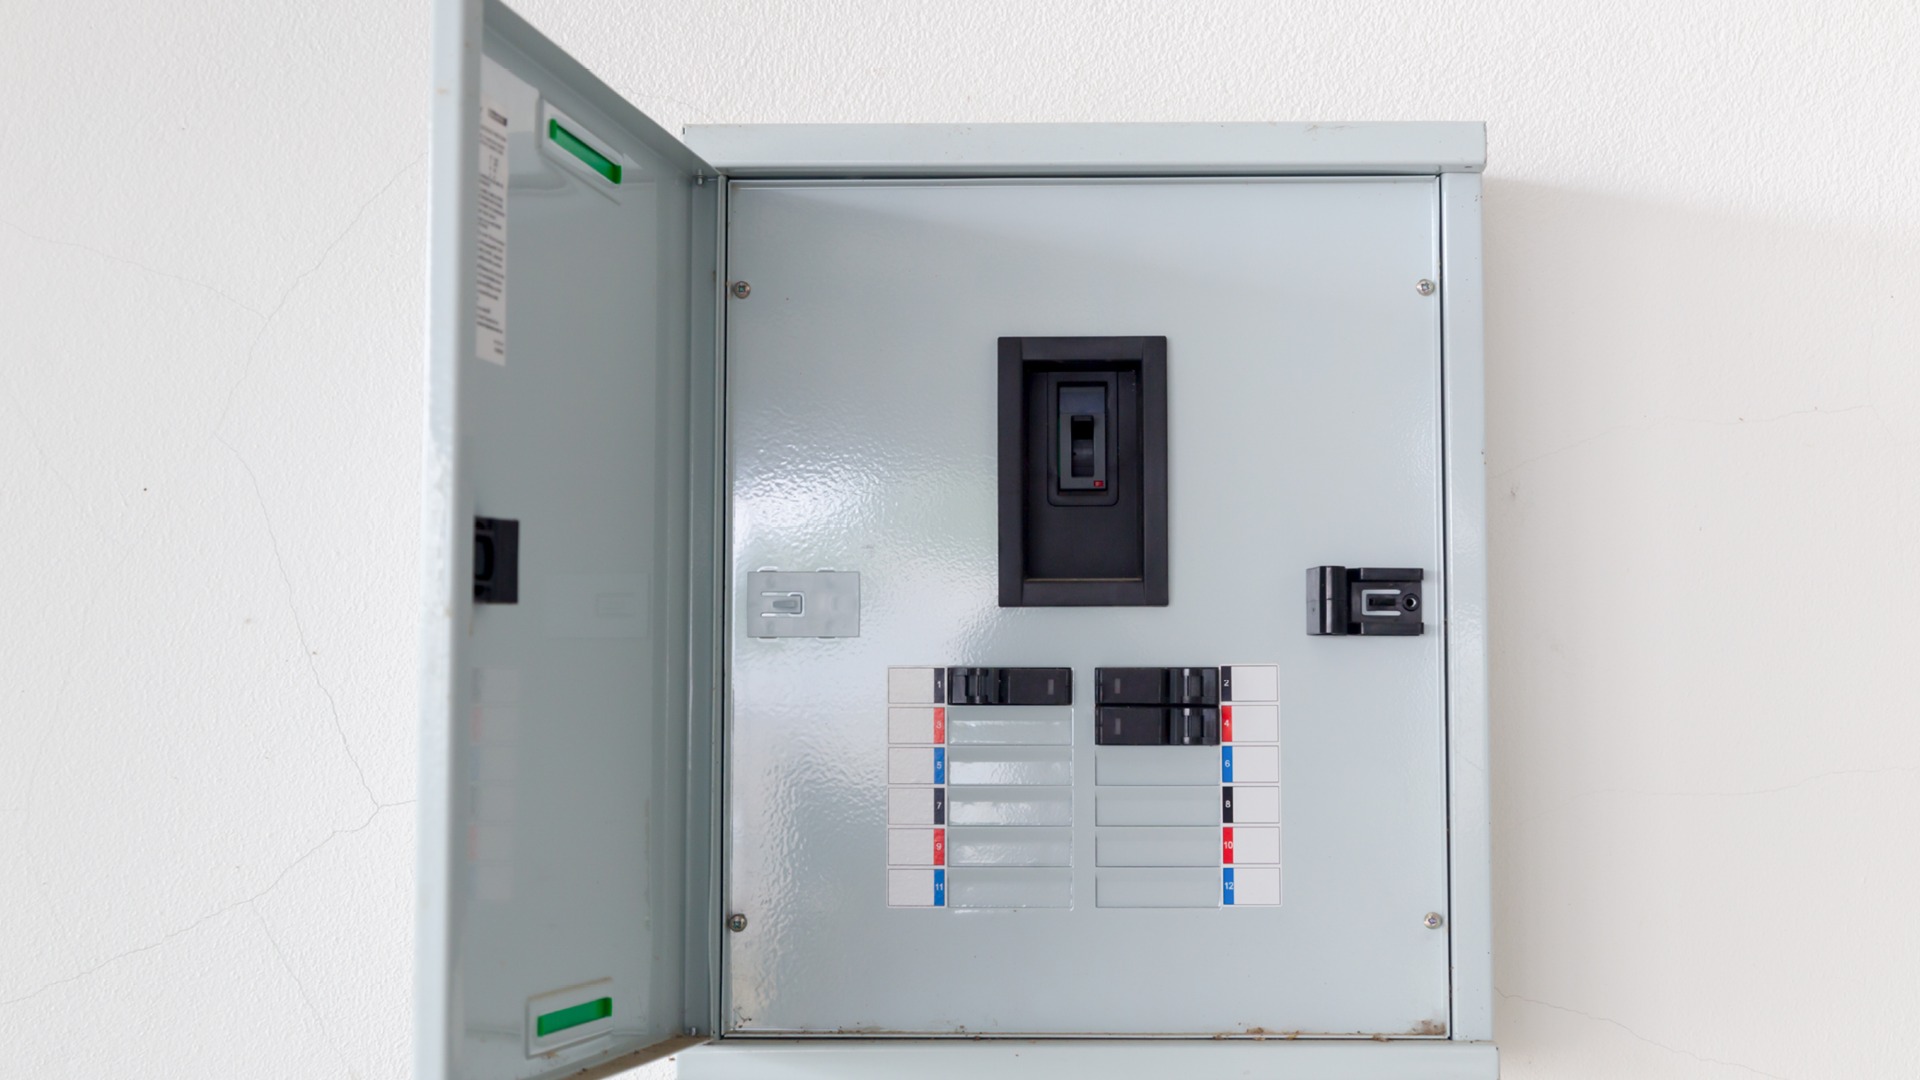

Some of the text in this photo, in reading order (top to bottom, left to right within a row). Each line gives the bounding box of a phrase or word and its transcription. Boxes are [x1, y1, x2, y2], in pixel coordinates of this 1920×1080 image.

[937, 680, 942, 689] 1
[1224, 680, 1230, 688] 2
[936, 721, 942, 729] 3
[1223, 719, 1230, 727] 4
[936, 761, 942, 769] 5
[1224, 759, 1231, 768] 6
[936, 801, 942, 810] 7
[1225, 800, 1231, 808] 8
[936, 842, 942, 851] 9
[1223, 840, 1234, 850] 10
[935, 883, 944, 891] 11
[1224, 881, 1234, 890] 12
